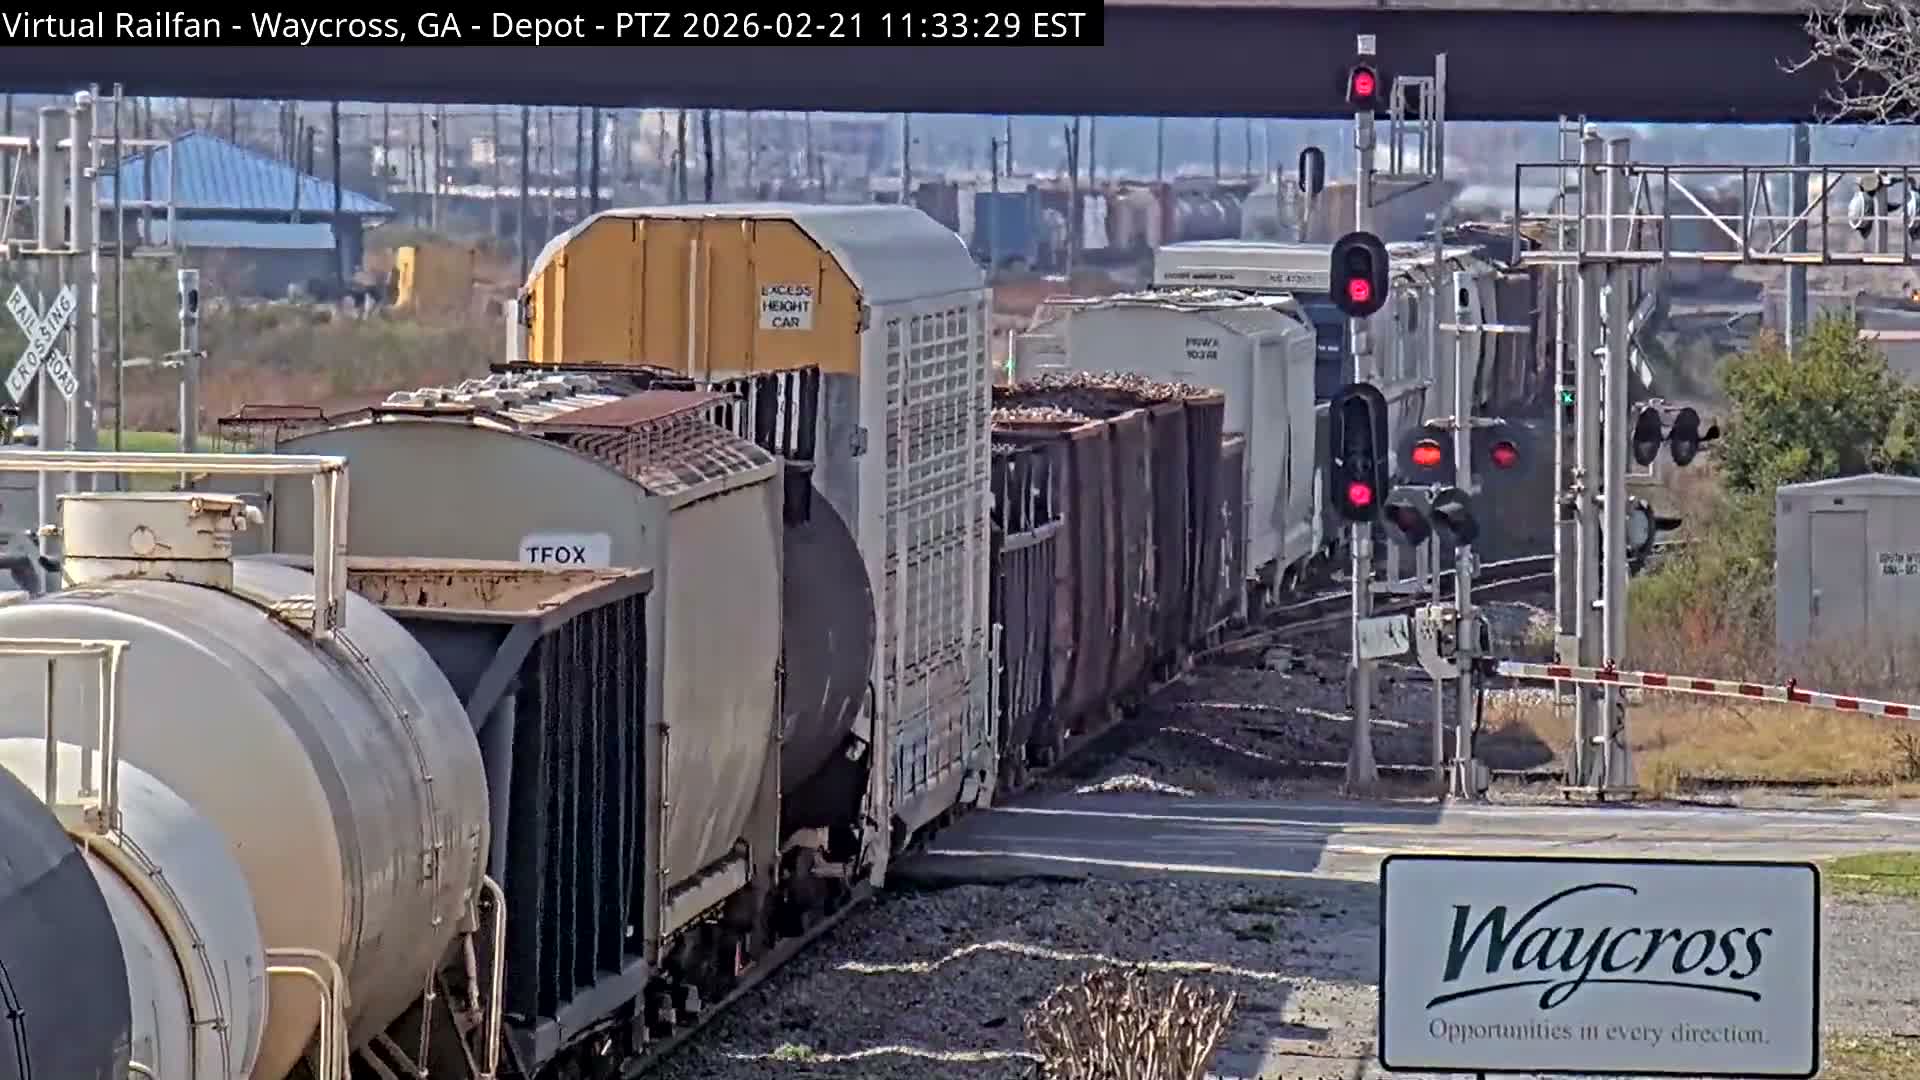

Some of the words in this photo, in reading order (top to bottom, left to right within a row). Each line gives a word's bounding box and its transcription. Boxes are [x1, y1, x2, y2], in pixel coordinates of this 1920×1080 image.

[9, 291, 36, 337] RAIL
[762, 300, 809, 312] HEIGHT
[772, 317, 800, 328] CAR
[11, 296, 71, 391] CROSSING
[48, 350, 76, 395] ROAD
[526, 546, 586, 564] TFOX
[1443, 882, 1774, 1010] Waycross
[1429, 1017, 1572, 1045] Opportunities
[1606, 1025, 1663, 1047] every
[1671, 1021, 1771, 1045] direction.
